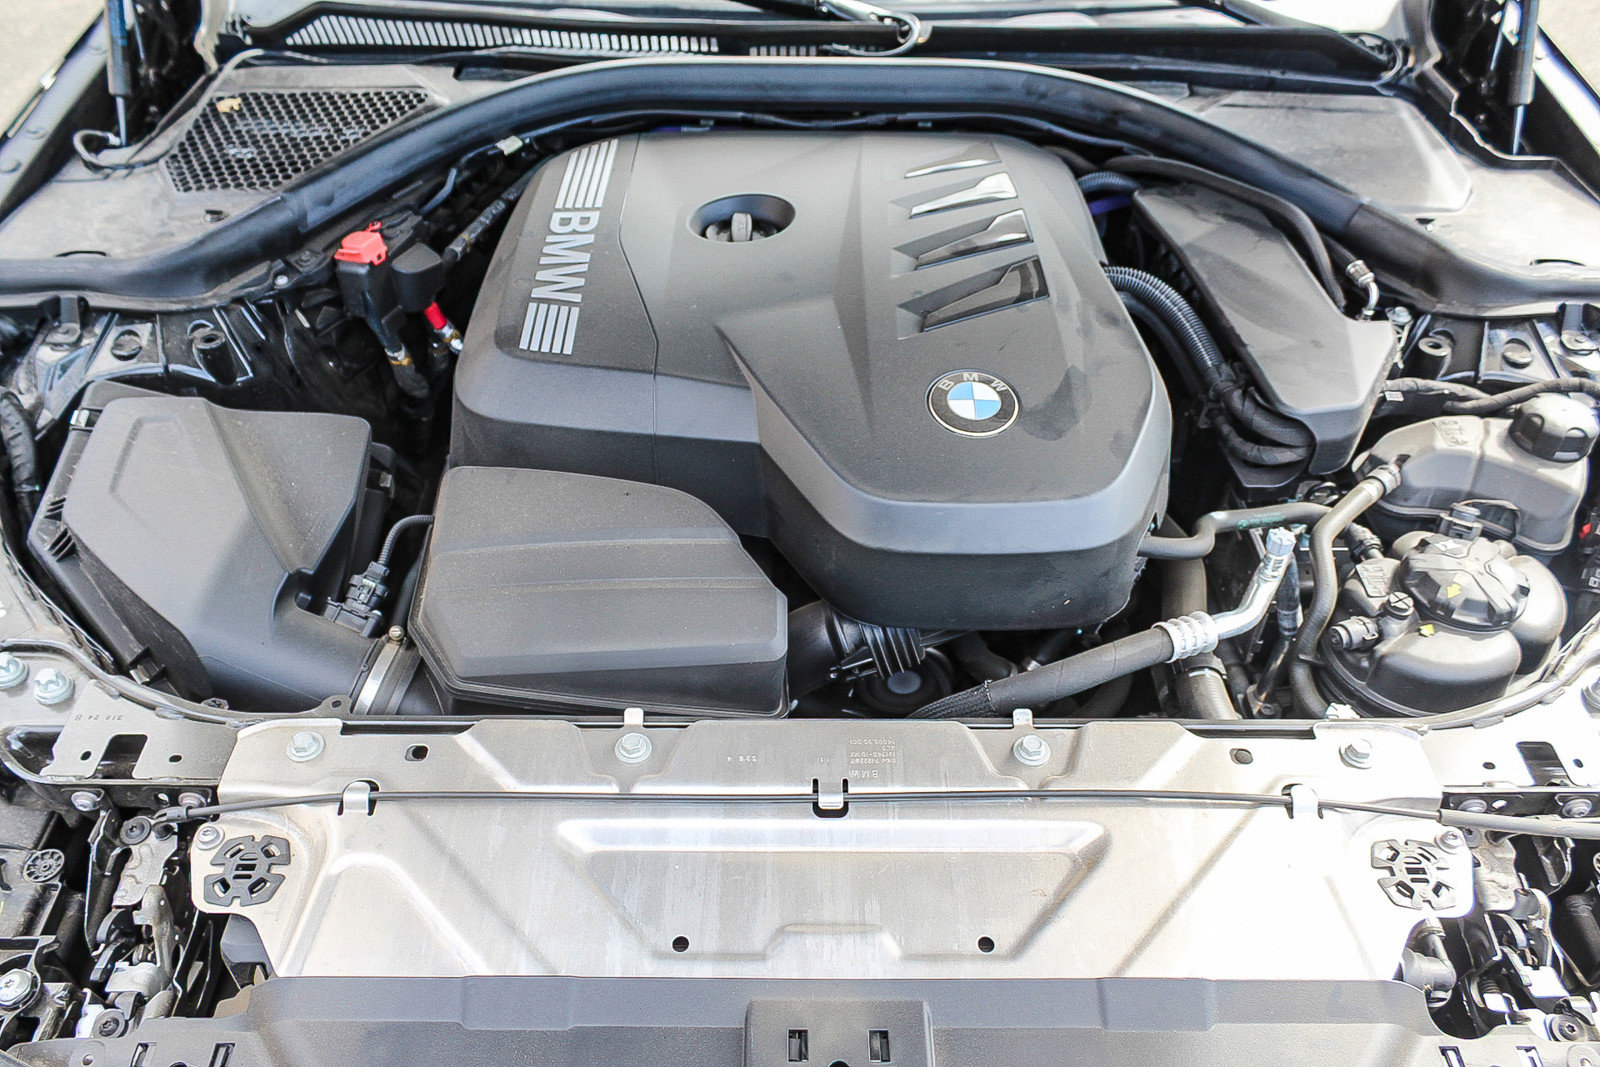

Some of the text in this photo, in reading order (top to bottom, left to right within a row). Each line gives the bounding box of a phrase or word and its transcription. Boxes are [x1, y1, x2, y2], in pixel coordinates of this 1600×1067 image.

[530, 210, 600, 303] BMW
[938, 372, 1008, 391] BMW
[851, 769, 879, 779] BMW
